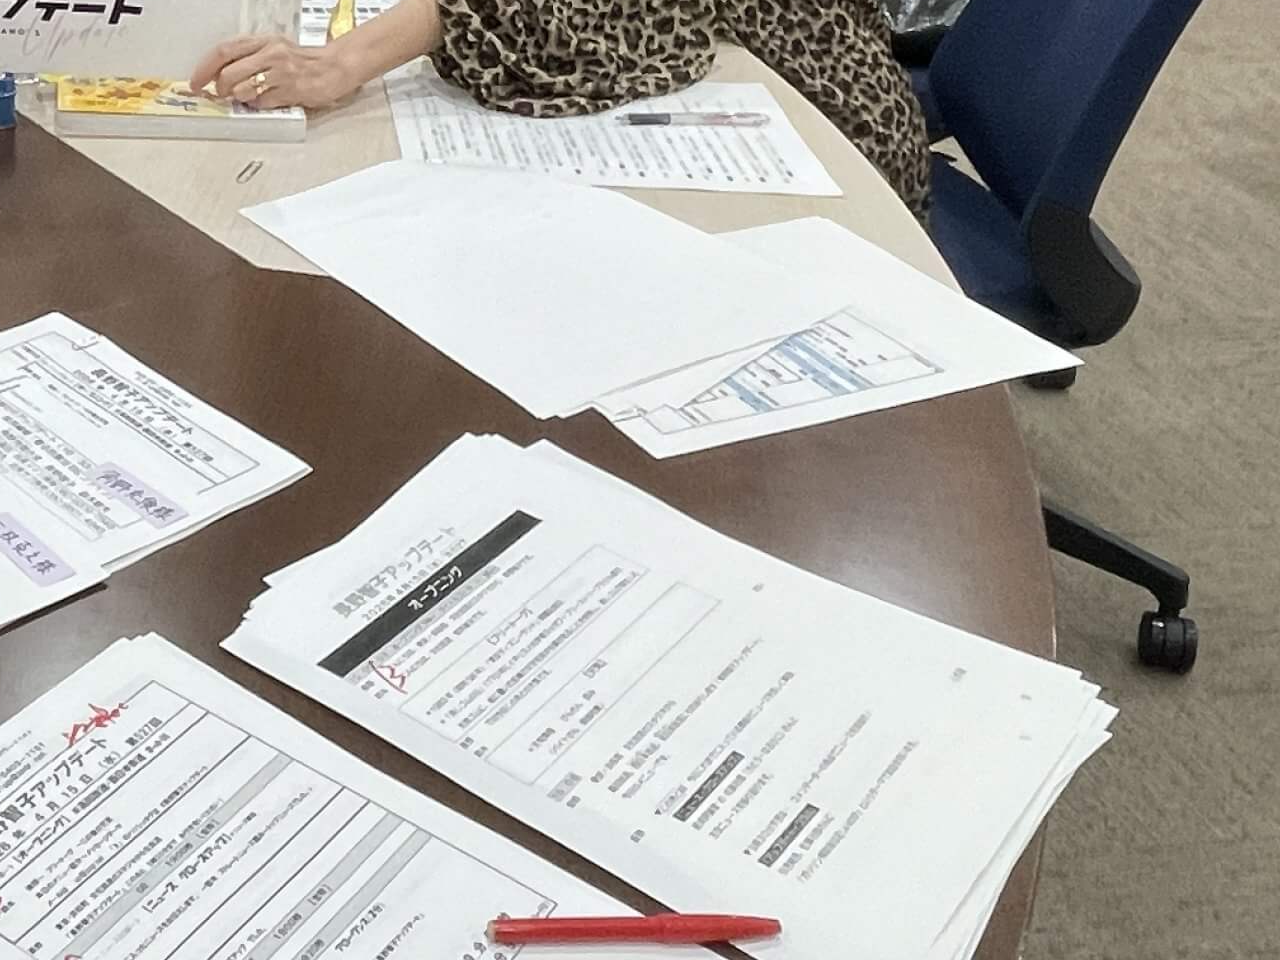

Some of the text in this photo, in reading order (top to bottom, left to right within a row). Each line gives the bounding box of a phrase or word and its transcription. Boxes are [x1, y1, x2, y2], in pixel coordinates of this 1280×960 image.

[407, 565, 464, 612] オープニング
